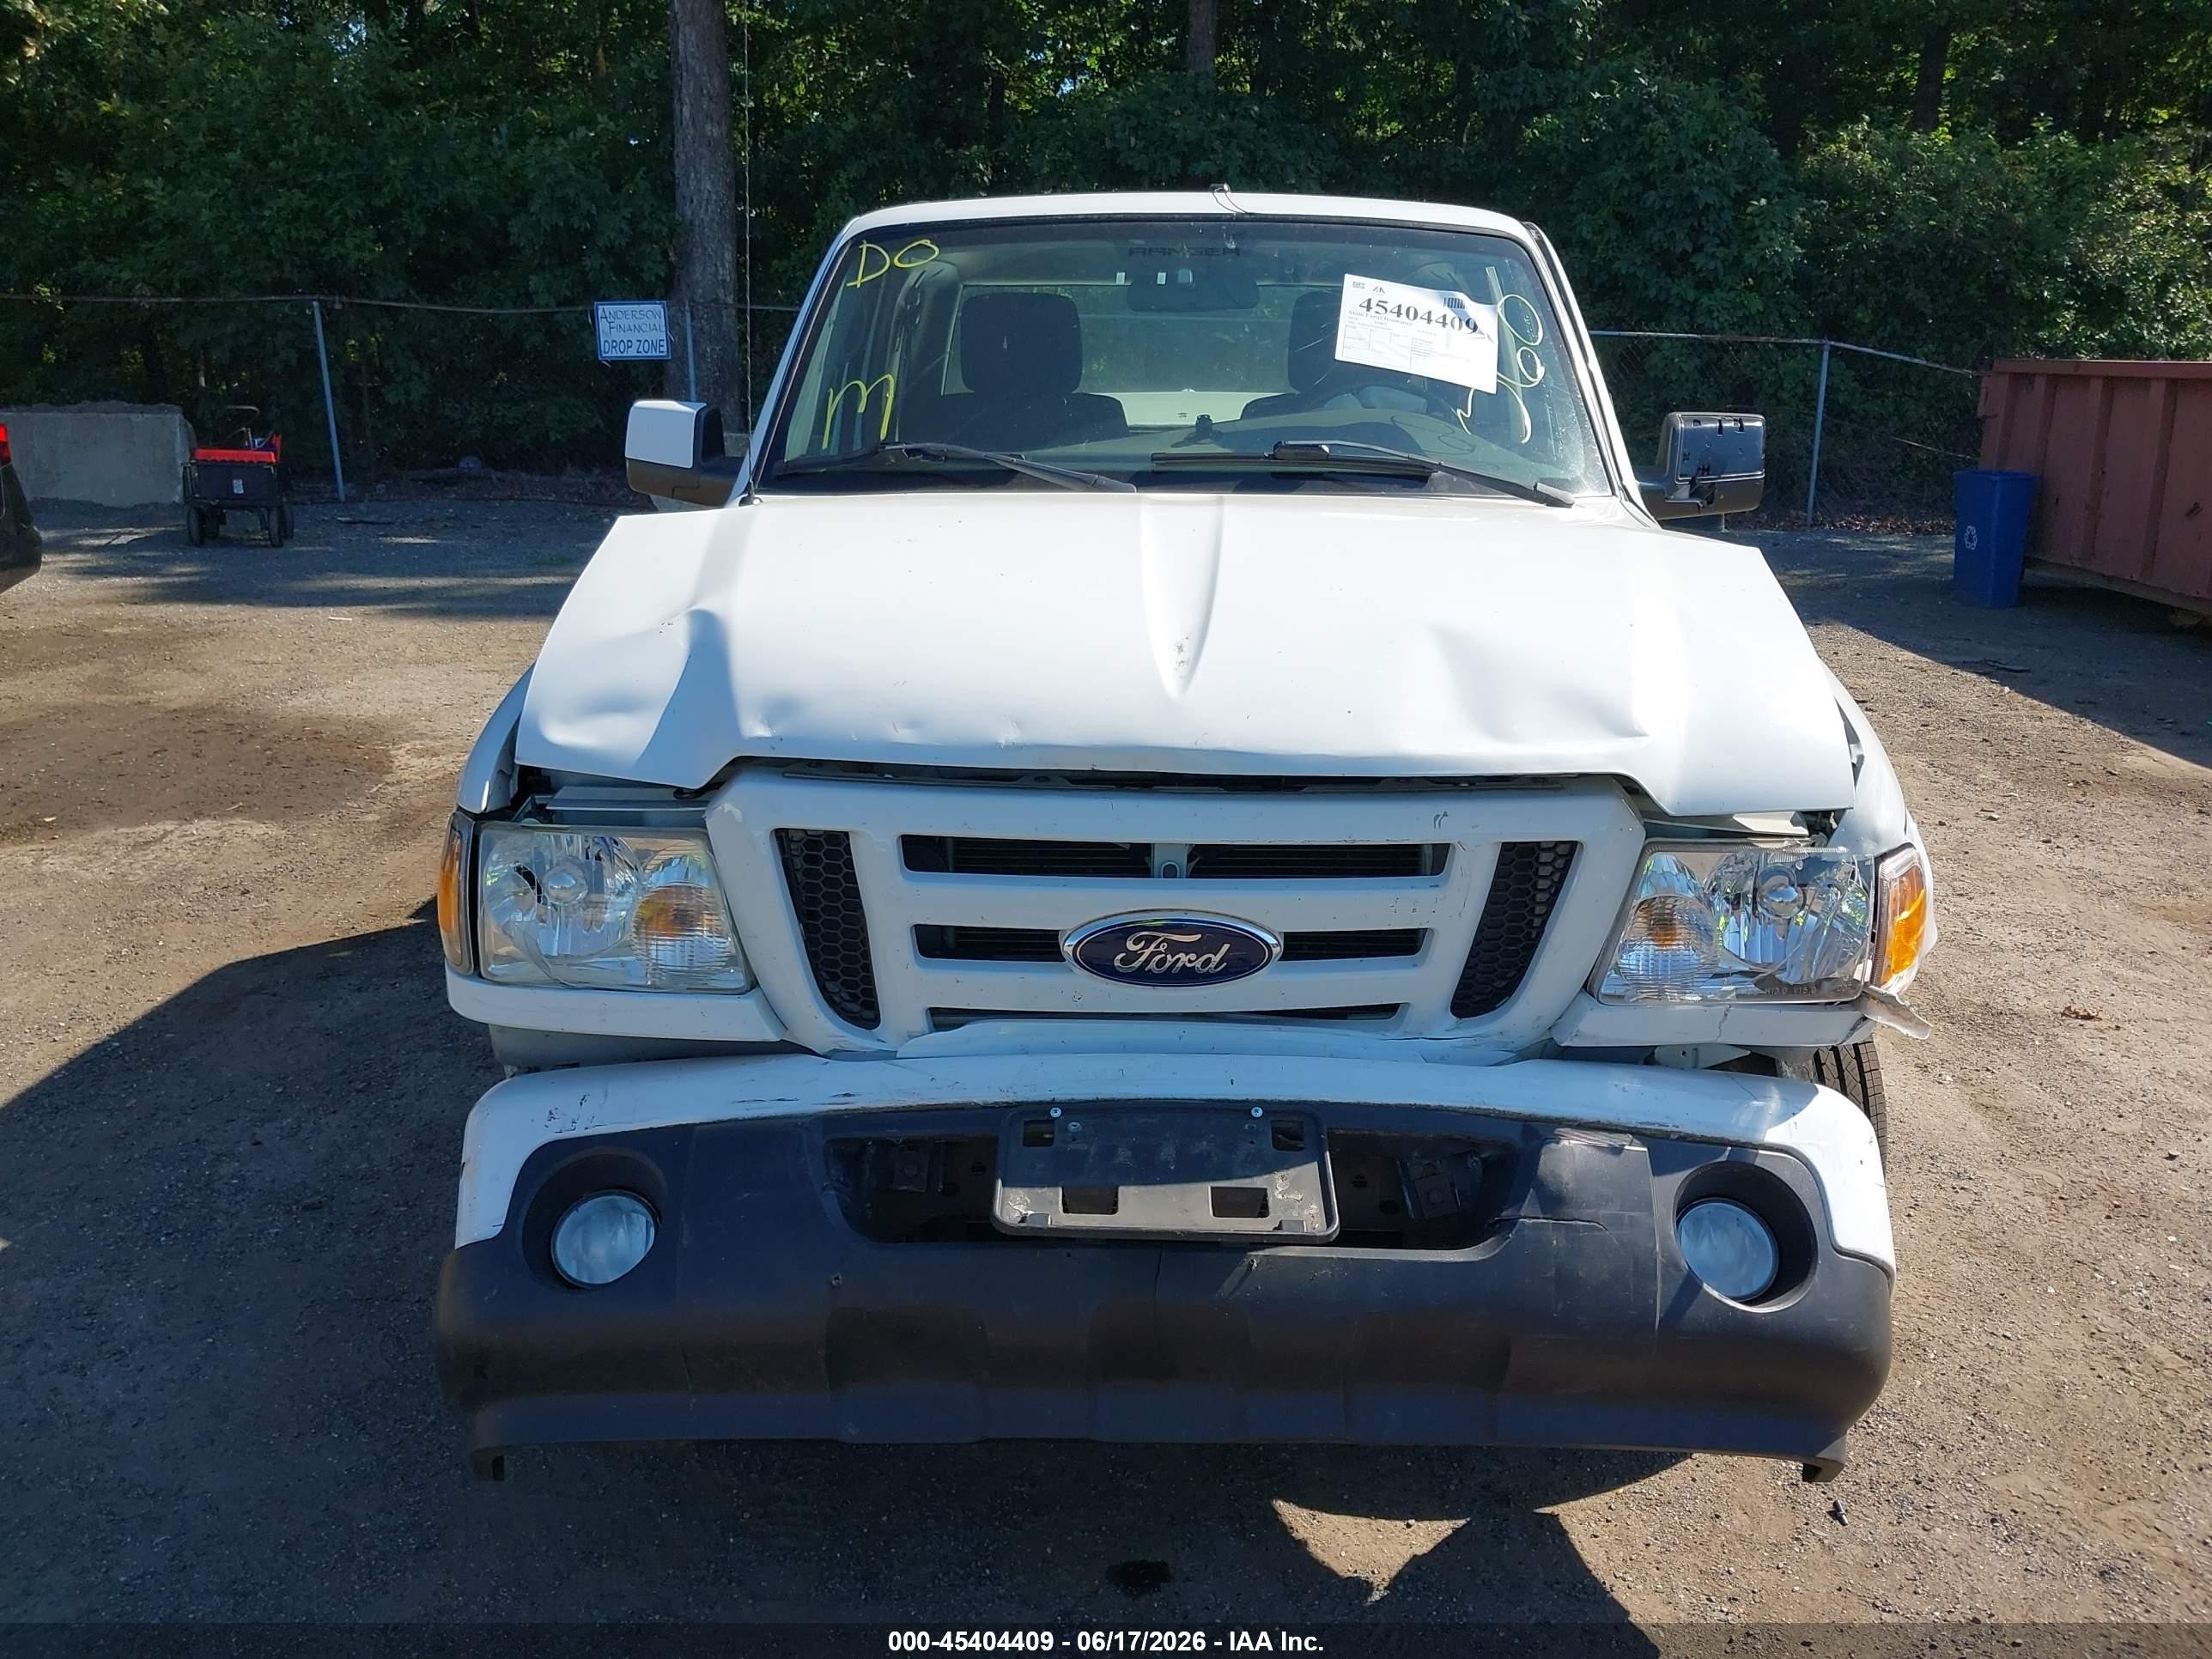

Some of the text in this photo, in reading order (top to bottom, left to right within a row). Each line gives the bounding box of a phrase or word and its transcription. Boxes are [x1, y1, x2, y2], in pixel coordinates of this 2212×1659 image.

[600, 307, 662, 322] ANDERSON
[1359, 298, 1478, 334] 45404409
[608, 321, 665, 334] FINANCIAL
[604, 339, 665, 354] DROP ZONE
[1114, 930, 1231, 974] Ford
